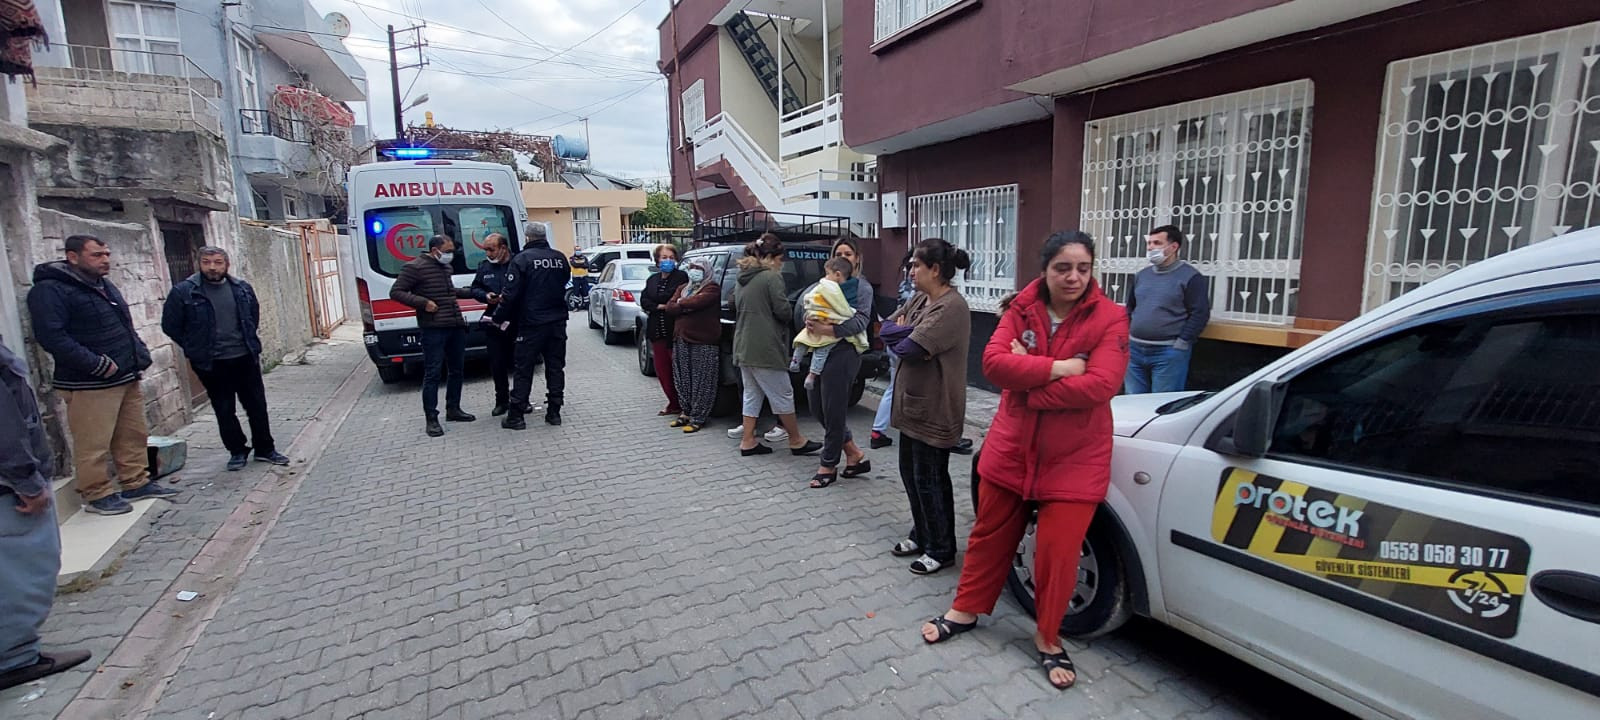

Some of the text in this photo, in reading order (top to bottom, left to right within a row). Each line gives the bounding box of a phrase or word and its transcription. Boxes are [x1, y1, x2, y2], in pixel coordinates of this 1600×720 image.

[374, 182, 494, 198] AMBULANS
[396, 234, 426, 249] 112
[788, 250, 830, 260] SUZUKI
[406, 335, 416, 344] 01
[1234, 482, 1364, 537] protek
[1380, 540, 1510, 569] 0553 058 30 77
[1315, 560, 1410, 580] GÜVENLİK SİSTEMLERİ
[1461, 577, 1500, 606] 7/24
